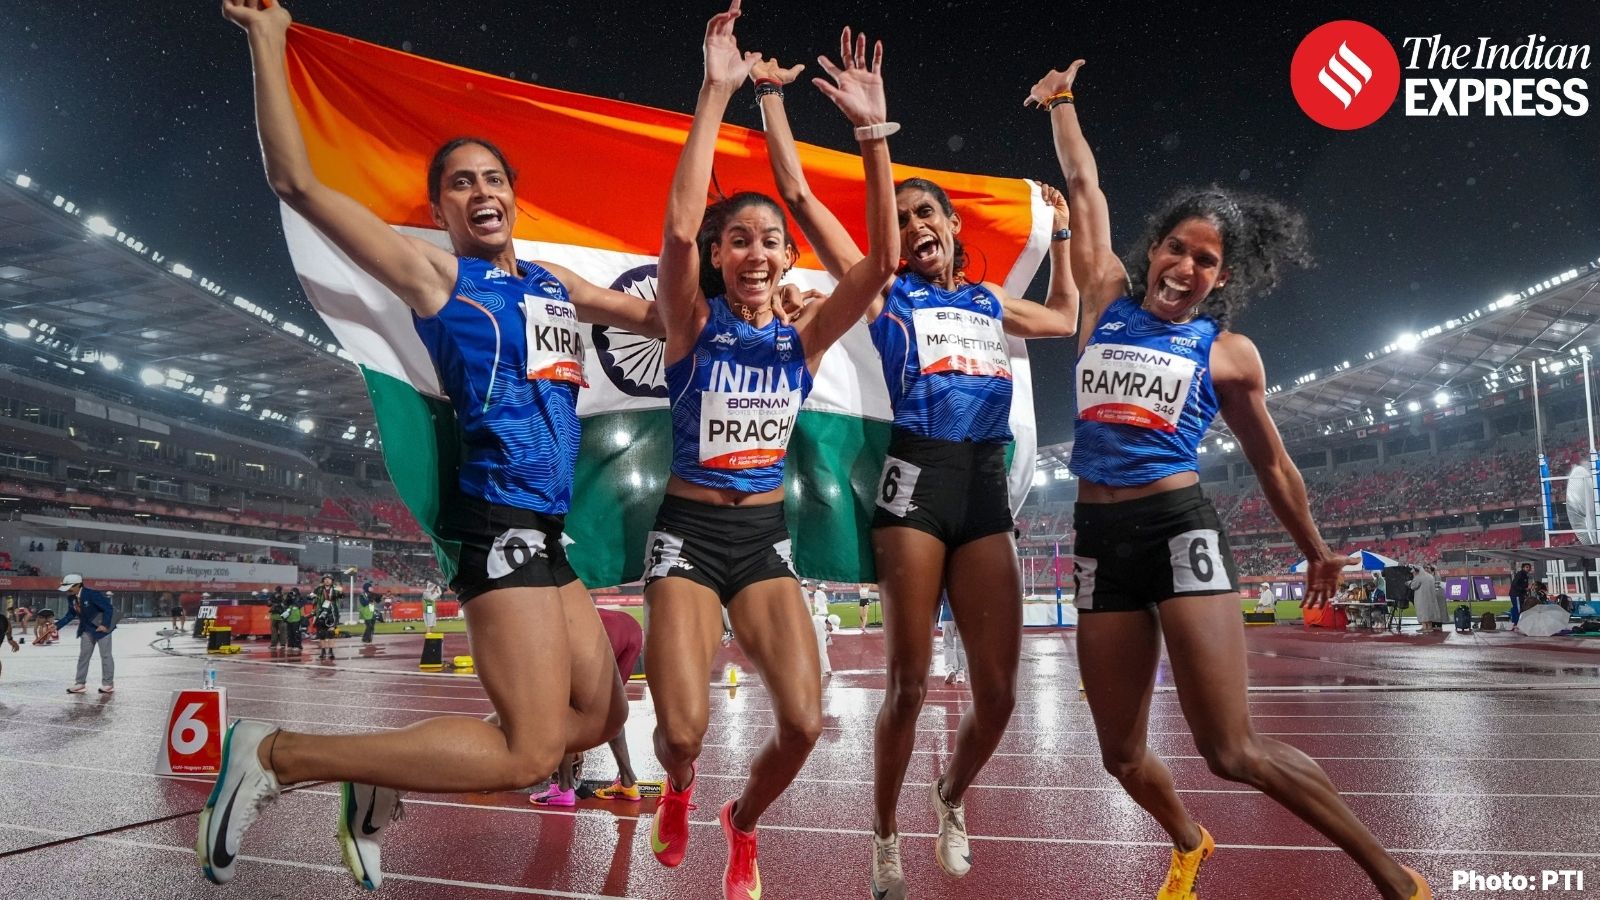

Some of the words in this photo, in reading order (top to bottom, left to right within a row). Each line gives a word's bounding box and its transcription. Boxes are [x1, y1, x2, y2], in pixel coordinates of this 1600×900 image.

[545, 304, 578, 319] BORN
[535, 325, 585, 356] KIRA
[926, 334, 1004, 352] MACHETTIRA
[1101, 349, 1171, 366] BORNAN
[709, 360, 790, 393] INDIA
[1082, 369, 1181, 403] RAMRAJ
[726, 397, 789, 408] BORNAN
[1153, 403, 1175, 415] 346
[709, 414, 794, 442] PRACHI
[883, 465, 901, 503] 6
[166, 565, 212, 578] Aichi-Nagoya
[1189, 537, 1213, 582] 6
[171, 702, 208, 755] 6
